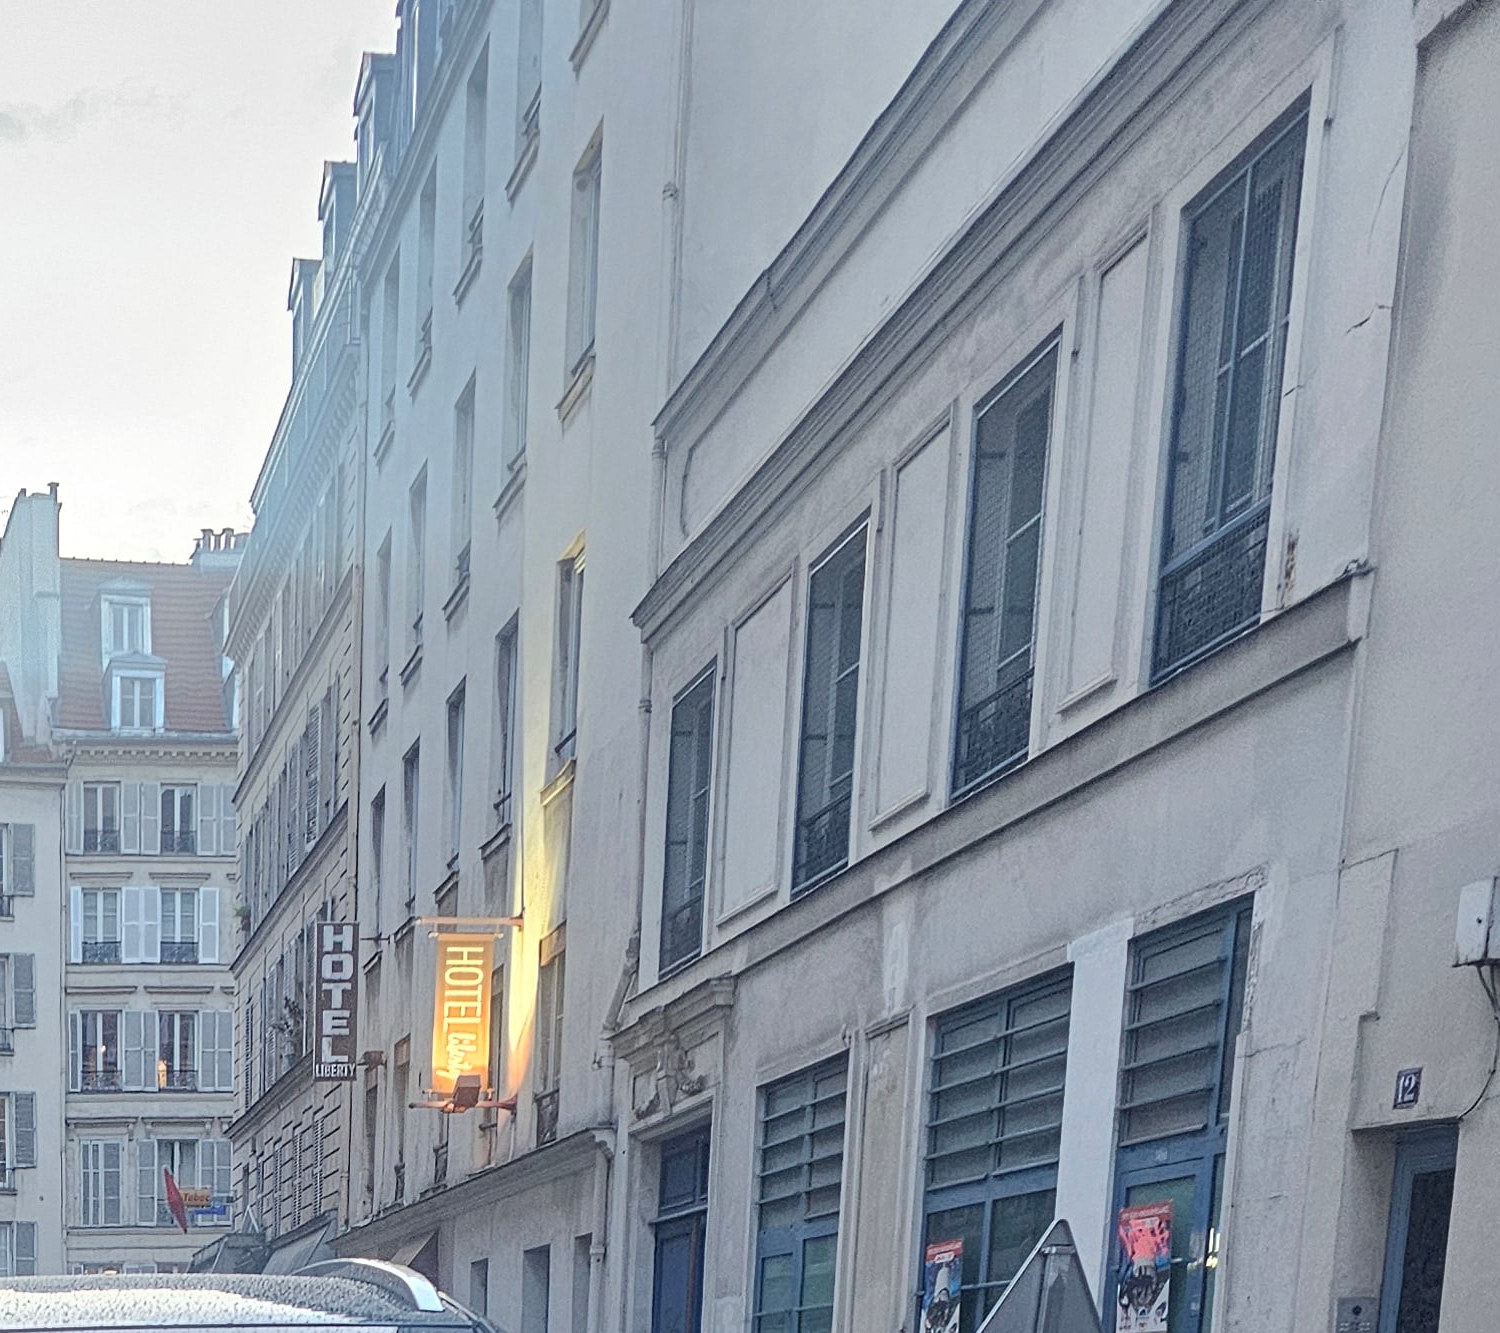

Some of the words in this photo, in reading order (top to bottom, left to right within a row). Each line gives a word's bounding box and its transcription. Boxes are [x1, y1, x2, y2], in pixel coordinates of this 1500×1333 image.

[322, 925, 354, 1063] HOTEL
[443, 946, 485, 1033] HOTEL
[315, 1064, 356, 1078] LIBERTY
[1397, 1074, 1416, 1103] 12
